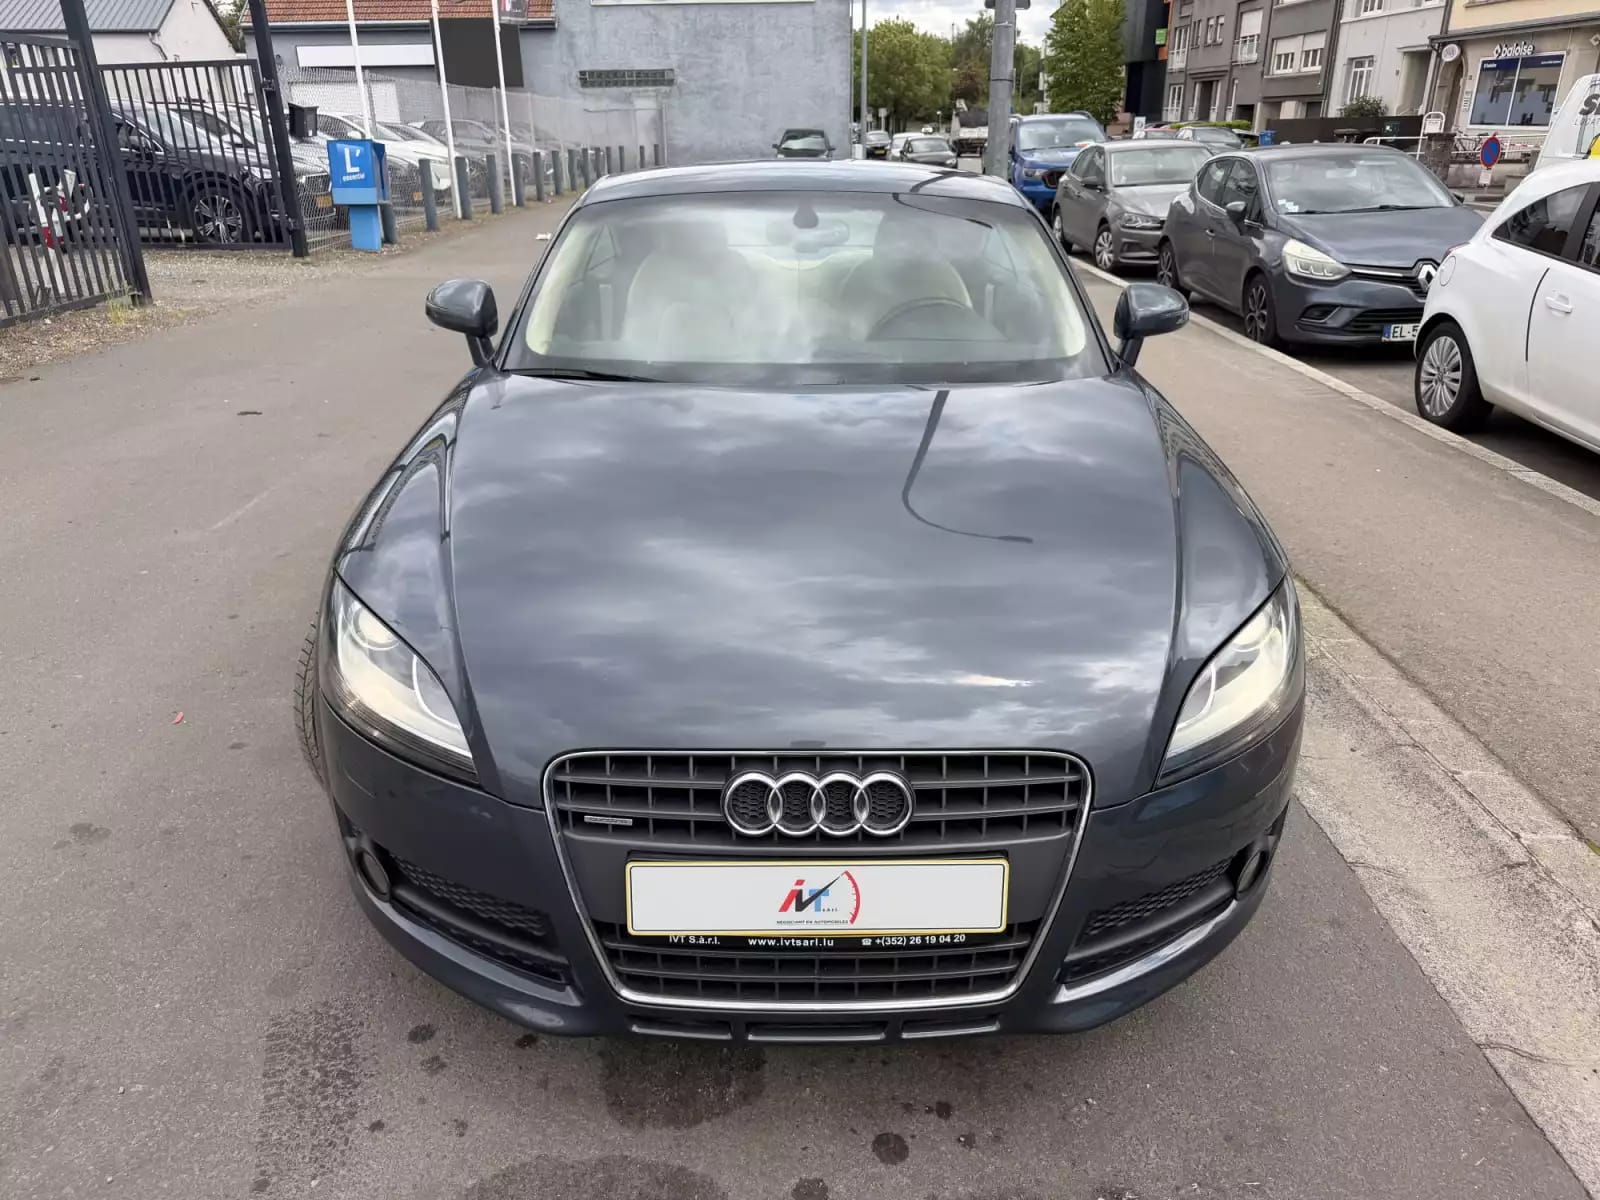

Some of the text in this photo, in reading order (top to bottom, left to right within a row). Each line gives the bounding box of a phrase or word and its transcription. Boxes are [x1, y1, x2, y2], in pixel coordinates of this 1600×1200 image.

[1501, 41, 1534, 57] baloise
[669, 935, 685, 943] IVT
[748, 938, 834, 947] www.ivtsarl.lu
[875, 934, 966, 947] +(352) 26 19 04 20
